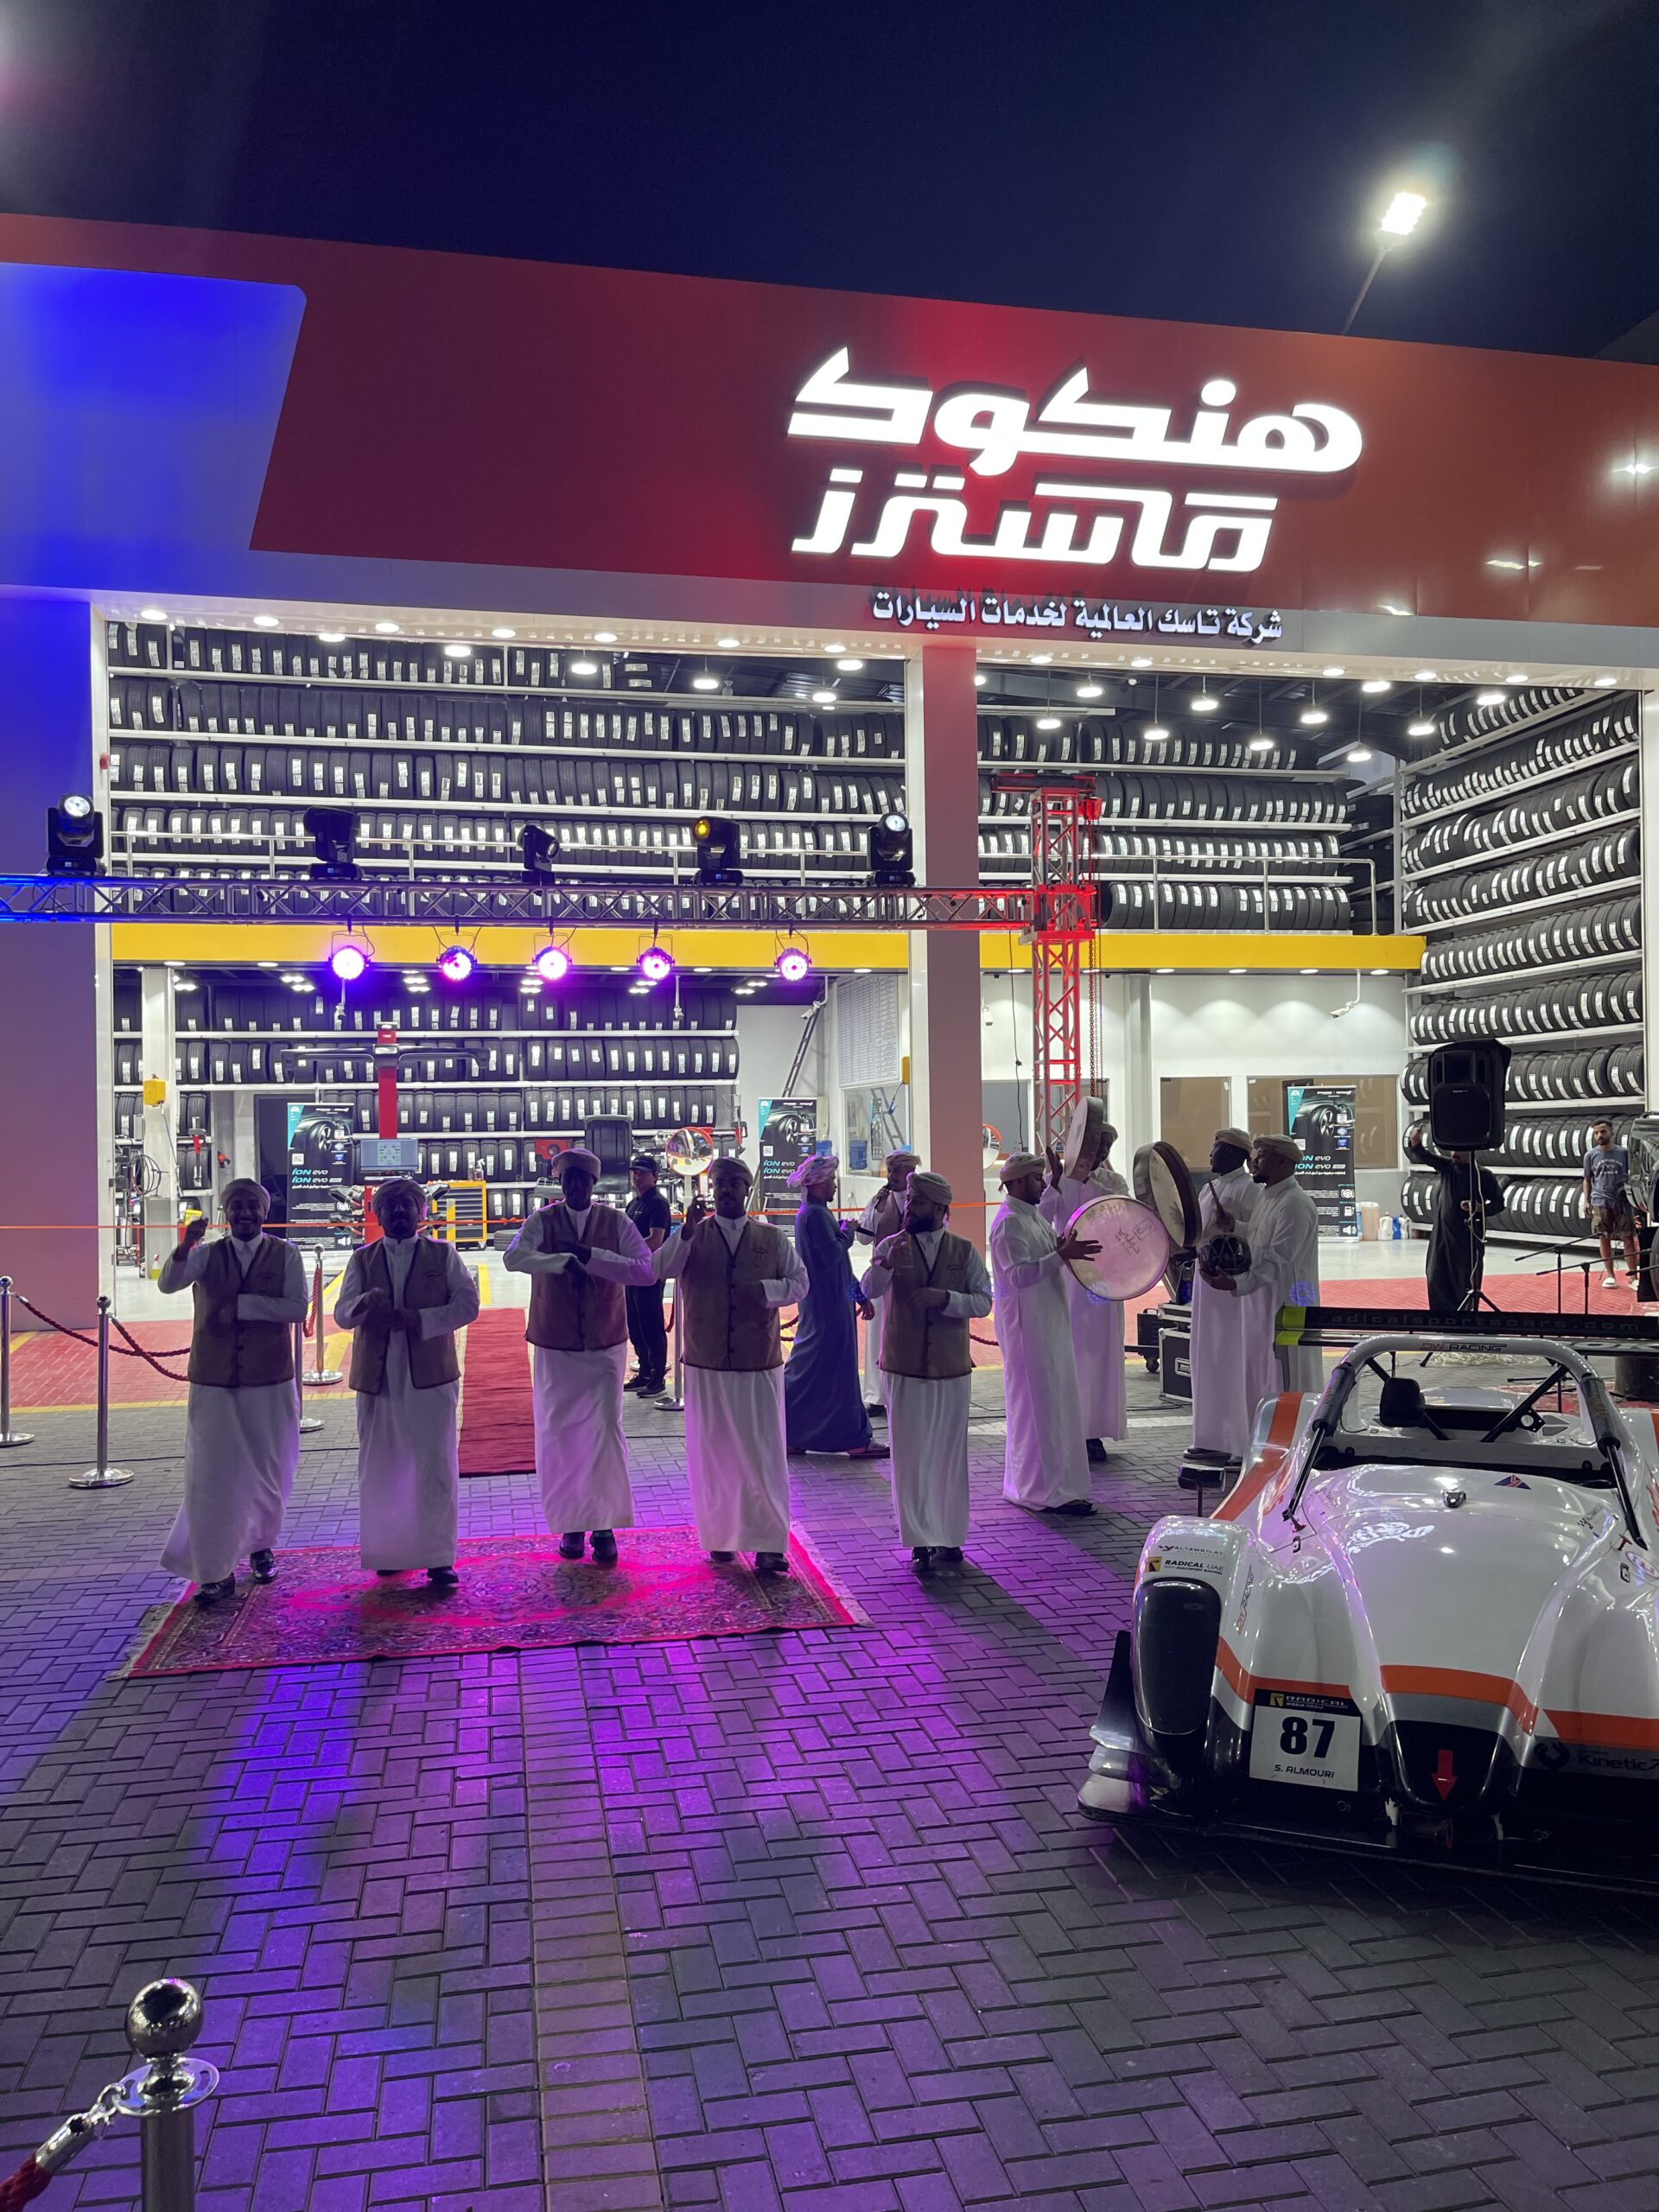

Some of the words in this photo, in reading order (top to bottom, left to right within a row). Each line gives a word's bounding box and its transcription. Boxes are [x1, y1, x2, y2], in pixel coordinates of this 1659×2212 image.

[787, 346, 1363, 477] هنكوك
[791, 467, 1279, 573] ماسترز
[873, 591, 976, 630] السيارات
[981, 596, 1067, 630] لخدمات
[1073, 599, 1154, 639] العالمية
[1159, 608, 1221, 634] تاسك
[1226, 608, 1283, 644] شركة
[1318, 1313, 1639, 1331] radicalsportscars.com
[1449, 1343, 1505, 1352] RACING
[1165, 1560, 1205, 1568] RADICAL
[1207, 1563, 1224, 1572] UAE
[1286, 1695, 1349, 1707] RADICAL
[1280, 1716, 1335, 1758] 87
[1286, 1765, 1335, 1779] ALMOURI
